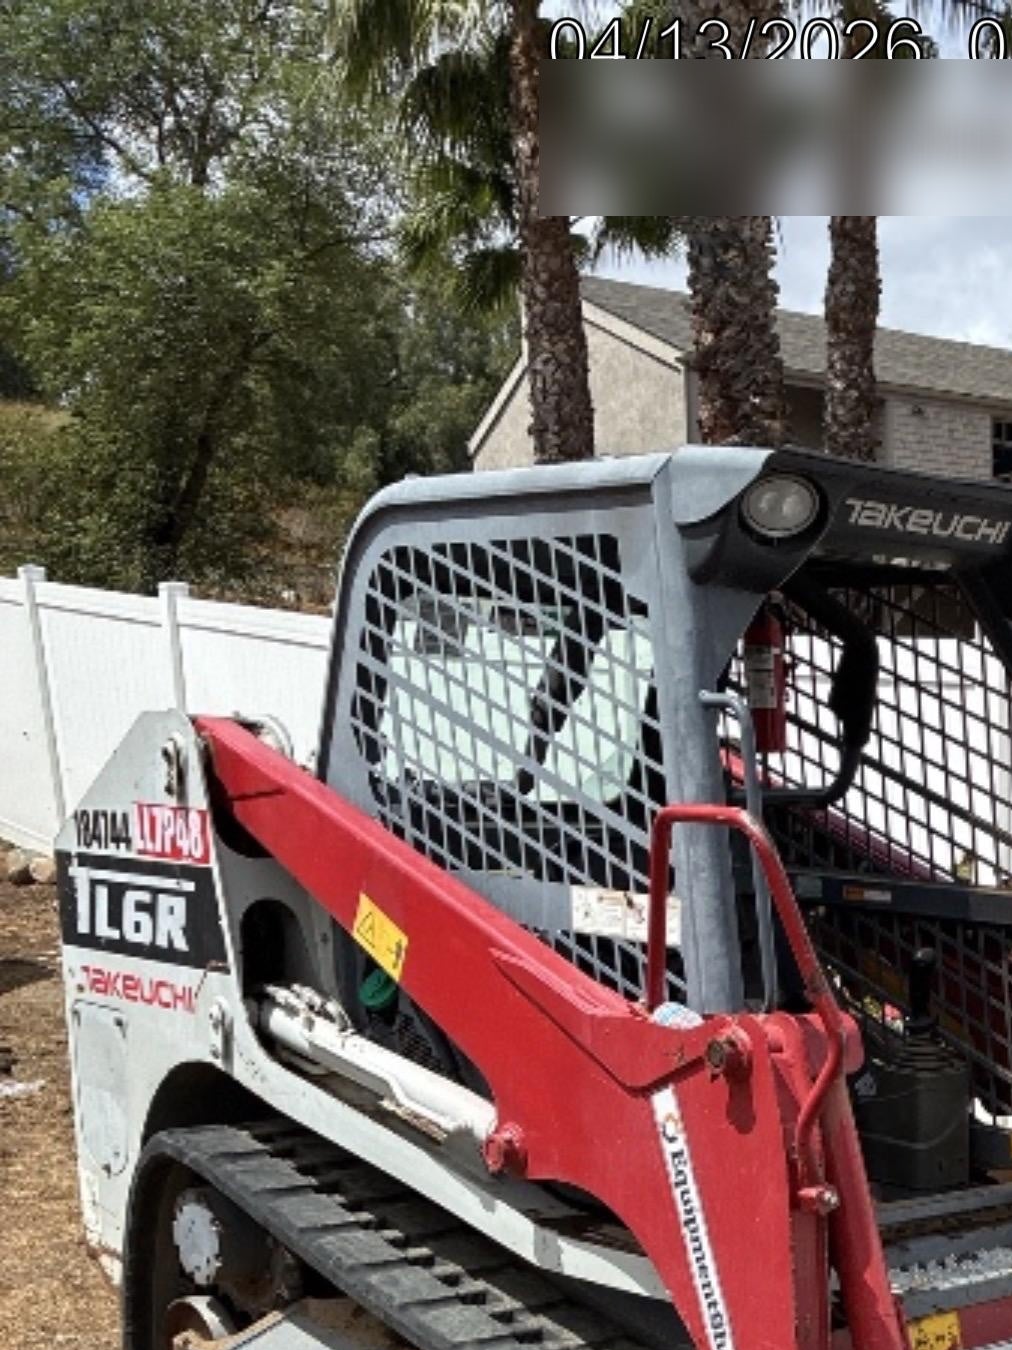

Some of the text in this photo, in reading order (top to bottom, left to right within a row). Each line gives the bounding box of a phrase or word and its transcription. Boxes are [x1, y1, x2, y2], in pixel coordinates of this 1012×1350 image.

[845, 499, 1012, 544] TAKEUCHI
[68, 866, 196, 952] TL6R
[81, 965, 196, 1014] TAKEUCHI
